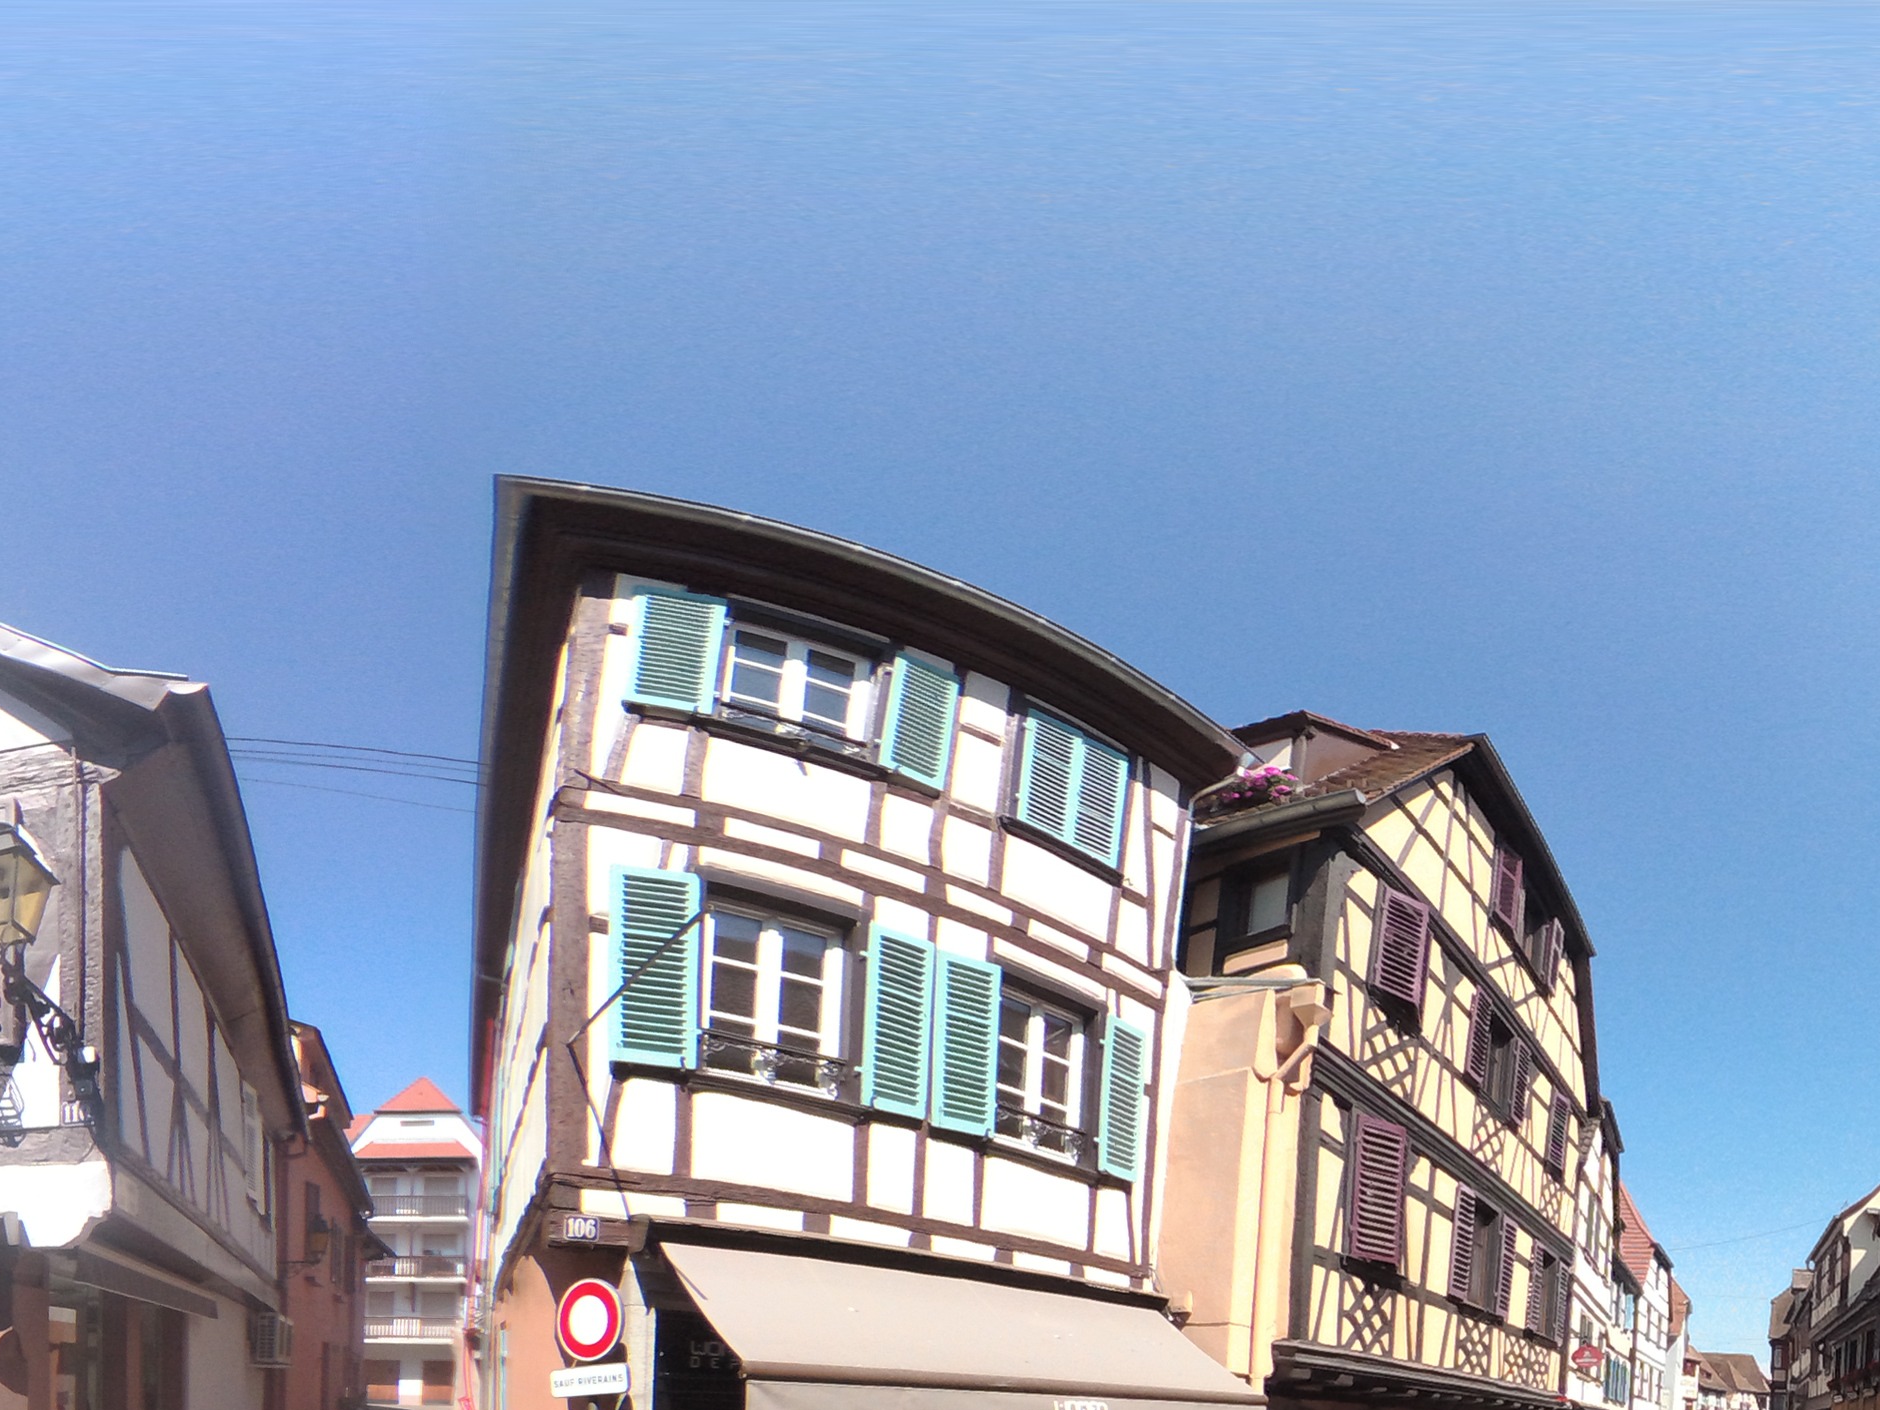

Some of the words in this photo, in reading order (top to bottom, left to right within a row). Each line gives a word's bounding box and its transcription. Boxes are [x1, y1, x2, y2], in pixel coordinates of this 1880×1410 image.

[567, 1217, 596, 1239] 106
[553, 1377, 575, 1389] SAUF
[577, 1373, 624, 1386] RIVERAINS
